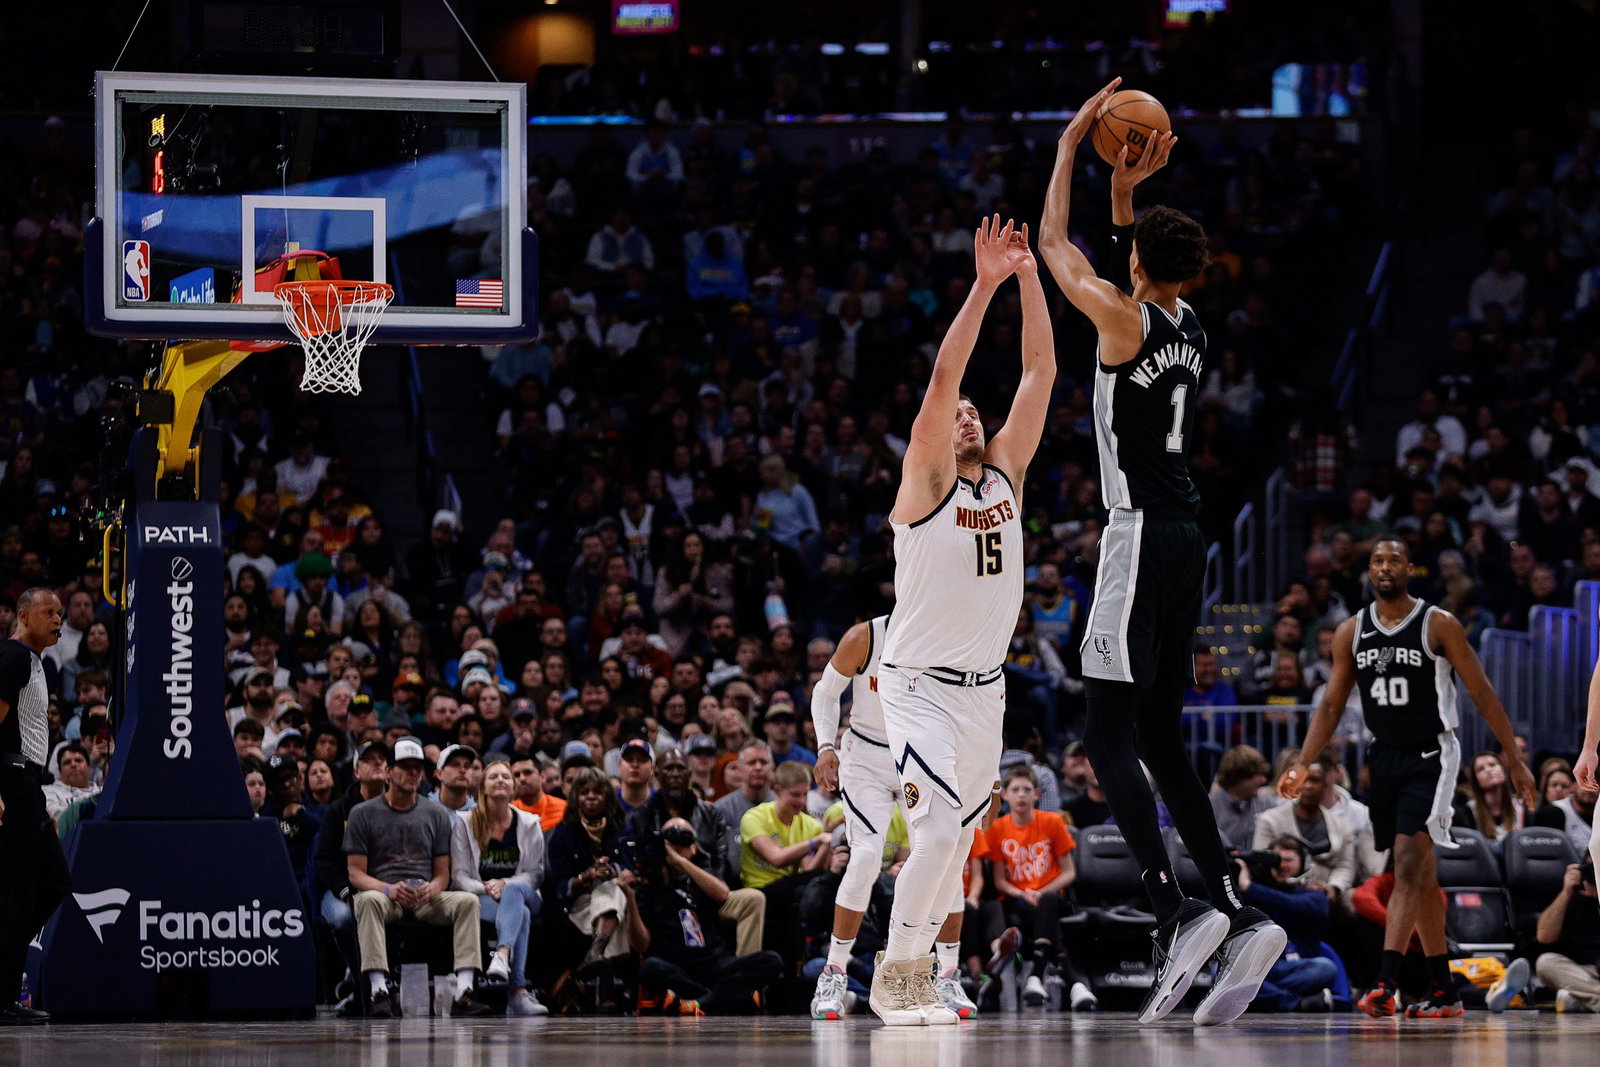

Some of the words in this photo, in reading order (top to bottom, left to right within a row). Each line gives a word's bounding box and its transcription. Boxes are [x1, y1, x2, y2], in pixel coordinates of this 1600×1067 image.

[127, 287, 140, 298] NBA
[1166, 384, 1188, 454] 1
[956, 500, 1014, 530] NUGGETS
[975, 531, 1003, 577] 15
[162, 581, 194, 759] Southwest
[1370, 676, 1409, 706] 40
[139, 899, 304, 941] Fanatics
[140, 945, 280, 973] Sportsbook
